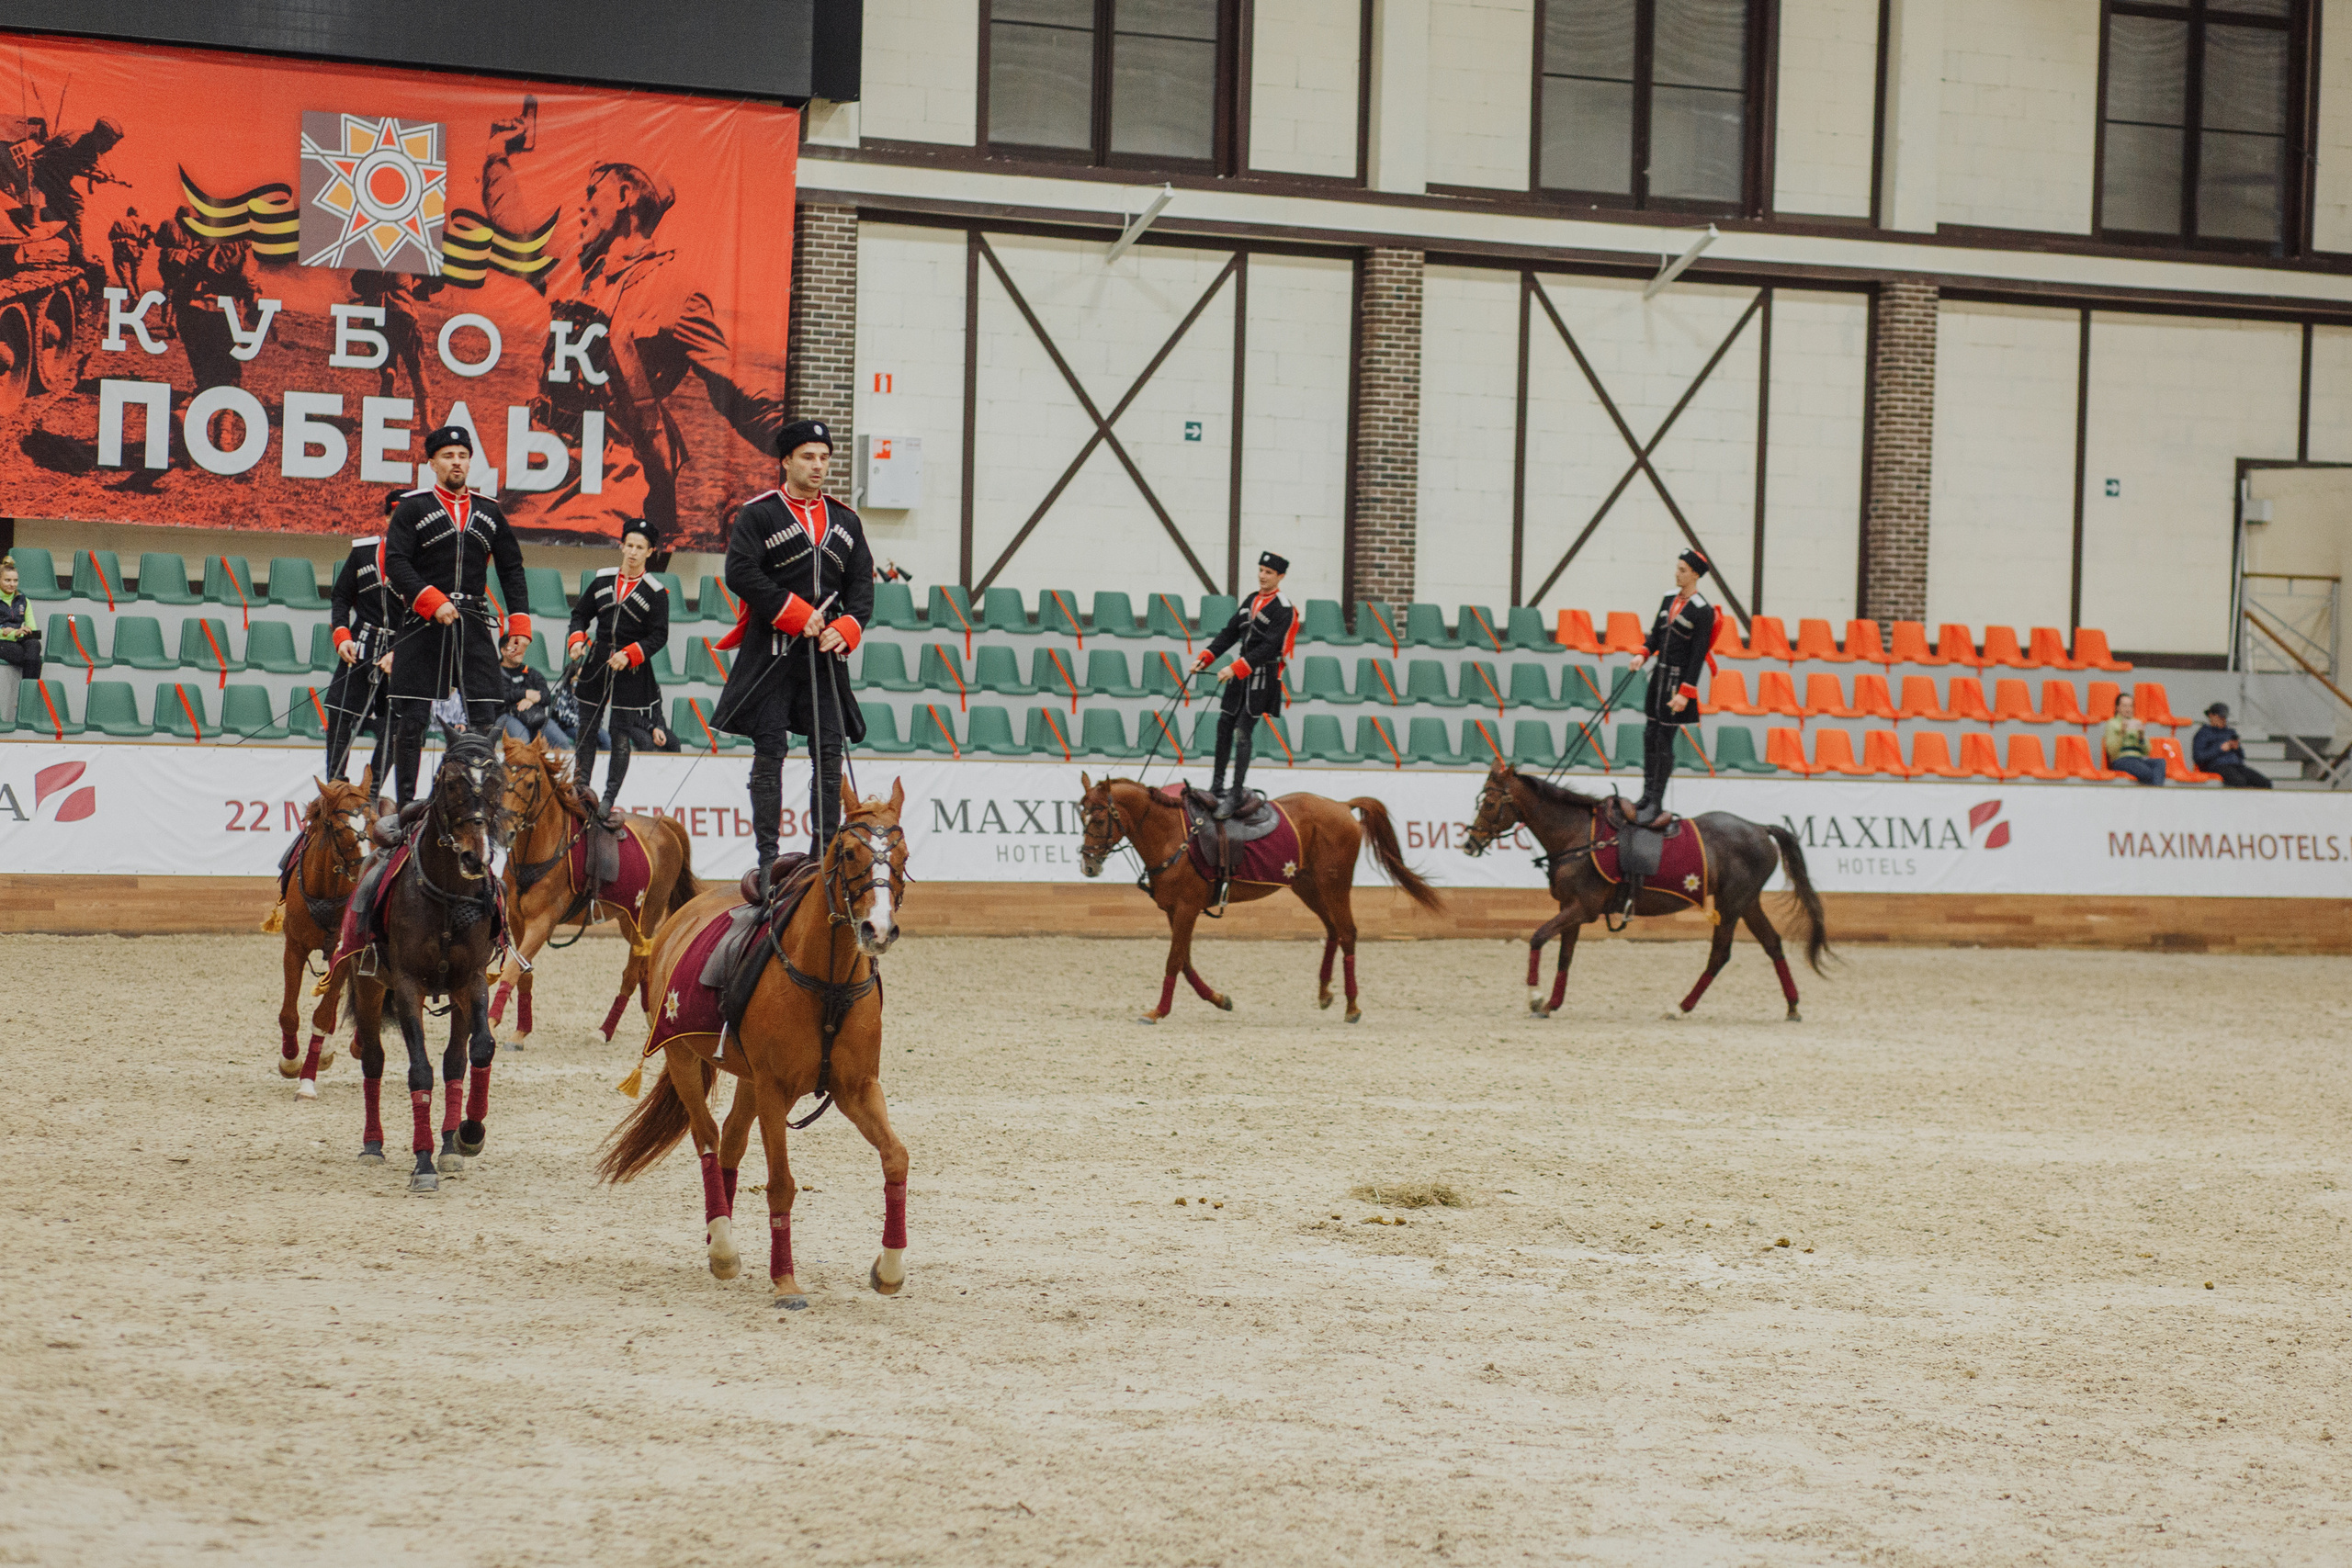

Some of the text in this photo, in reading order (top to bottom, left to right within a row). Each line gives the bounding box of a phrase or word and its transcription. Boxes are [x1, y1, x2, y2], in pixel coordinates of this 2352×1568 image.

[102, 287, 610, 386] КУБОК
[97, 378, 605, 497] ПОБЕДЫ
[225, 800, 270, 831] 22
[1781, 815, 1968, 850] MAXIMA
[2109, 831, 2352, 861] MAXIMAHOTELS.
[1838, 857, 1917, 874] HOTELS
